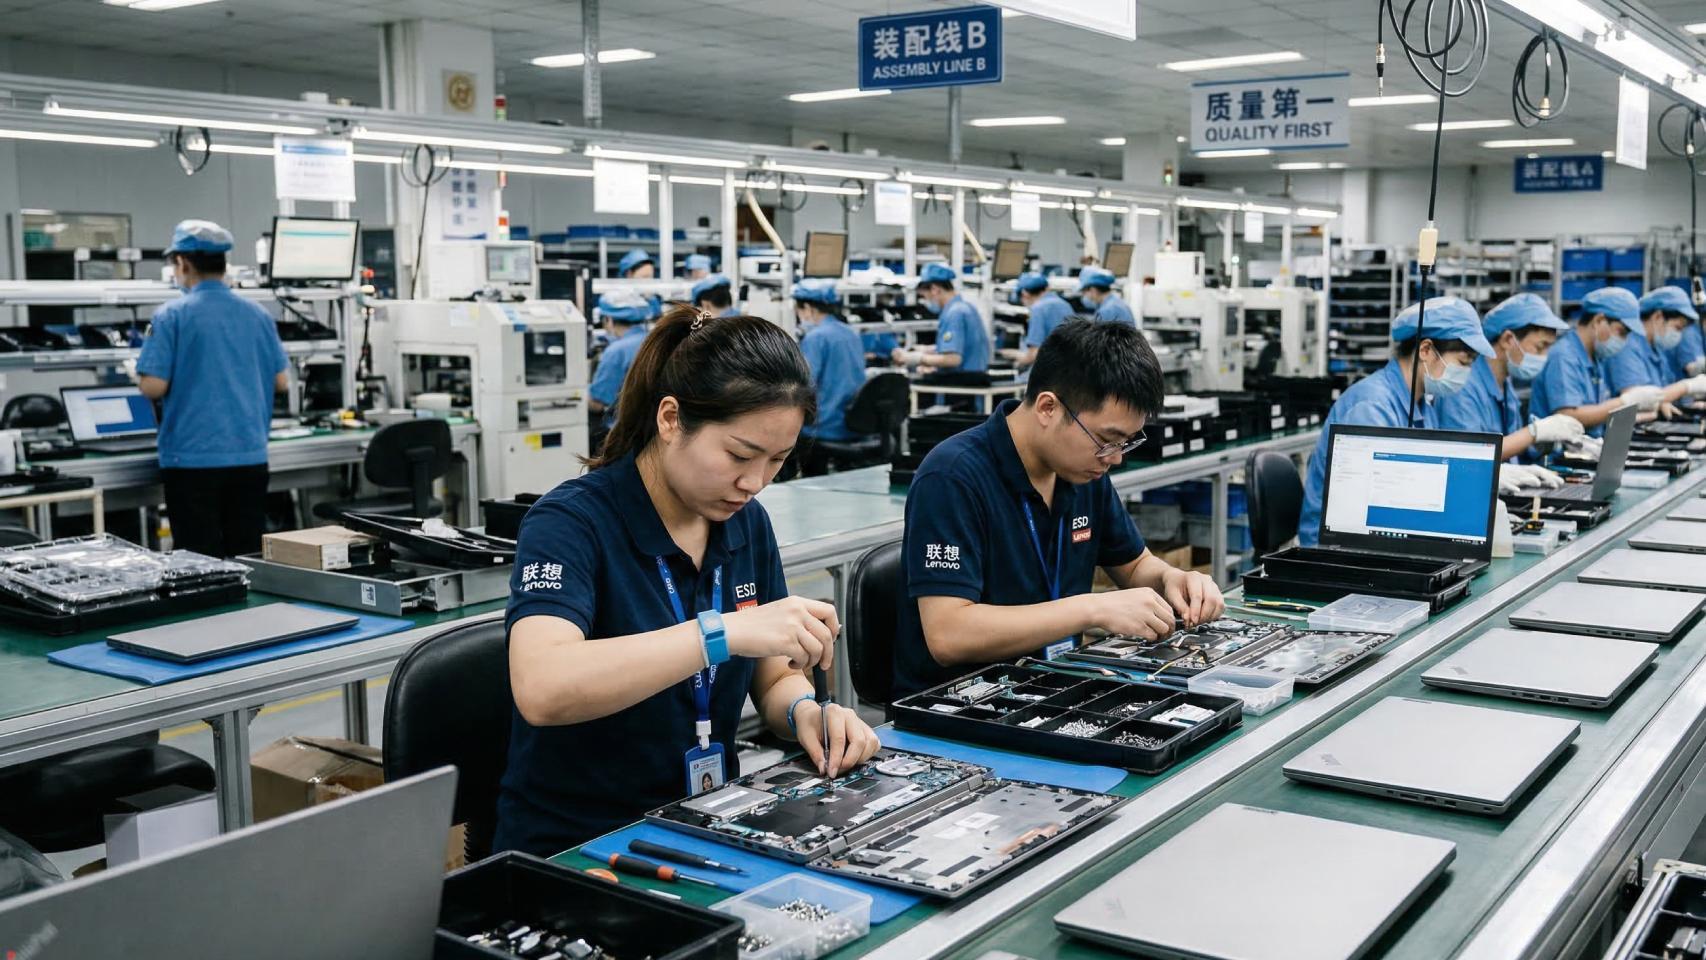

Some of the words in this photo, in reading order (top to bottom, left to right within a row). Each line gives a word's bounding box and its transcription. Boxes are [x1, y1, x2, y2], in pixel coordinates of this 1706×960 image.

[873, 21, 987, 60] 装配线B
[873, 61, 941, 79] ASSEMBLY
[944, 58, 973, 74] LINE
[976, 57, 986, 71] B
[1206, 87, 1334, 122] 质量第一
[1205, 124, 1279, 142] QUALITY
[1284, 121, 1333, 139] FIRST
[1072, 515, 1088, 529] ESD
[926, 543, 959, 560] 联想
[521, 562, 563, 583] 联想
[925, 560, 960, 570] Lenovo
[735, 582, 757, 599] ESD
